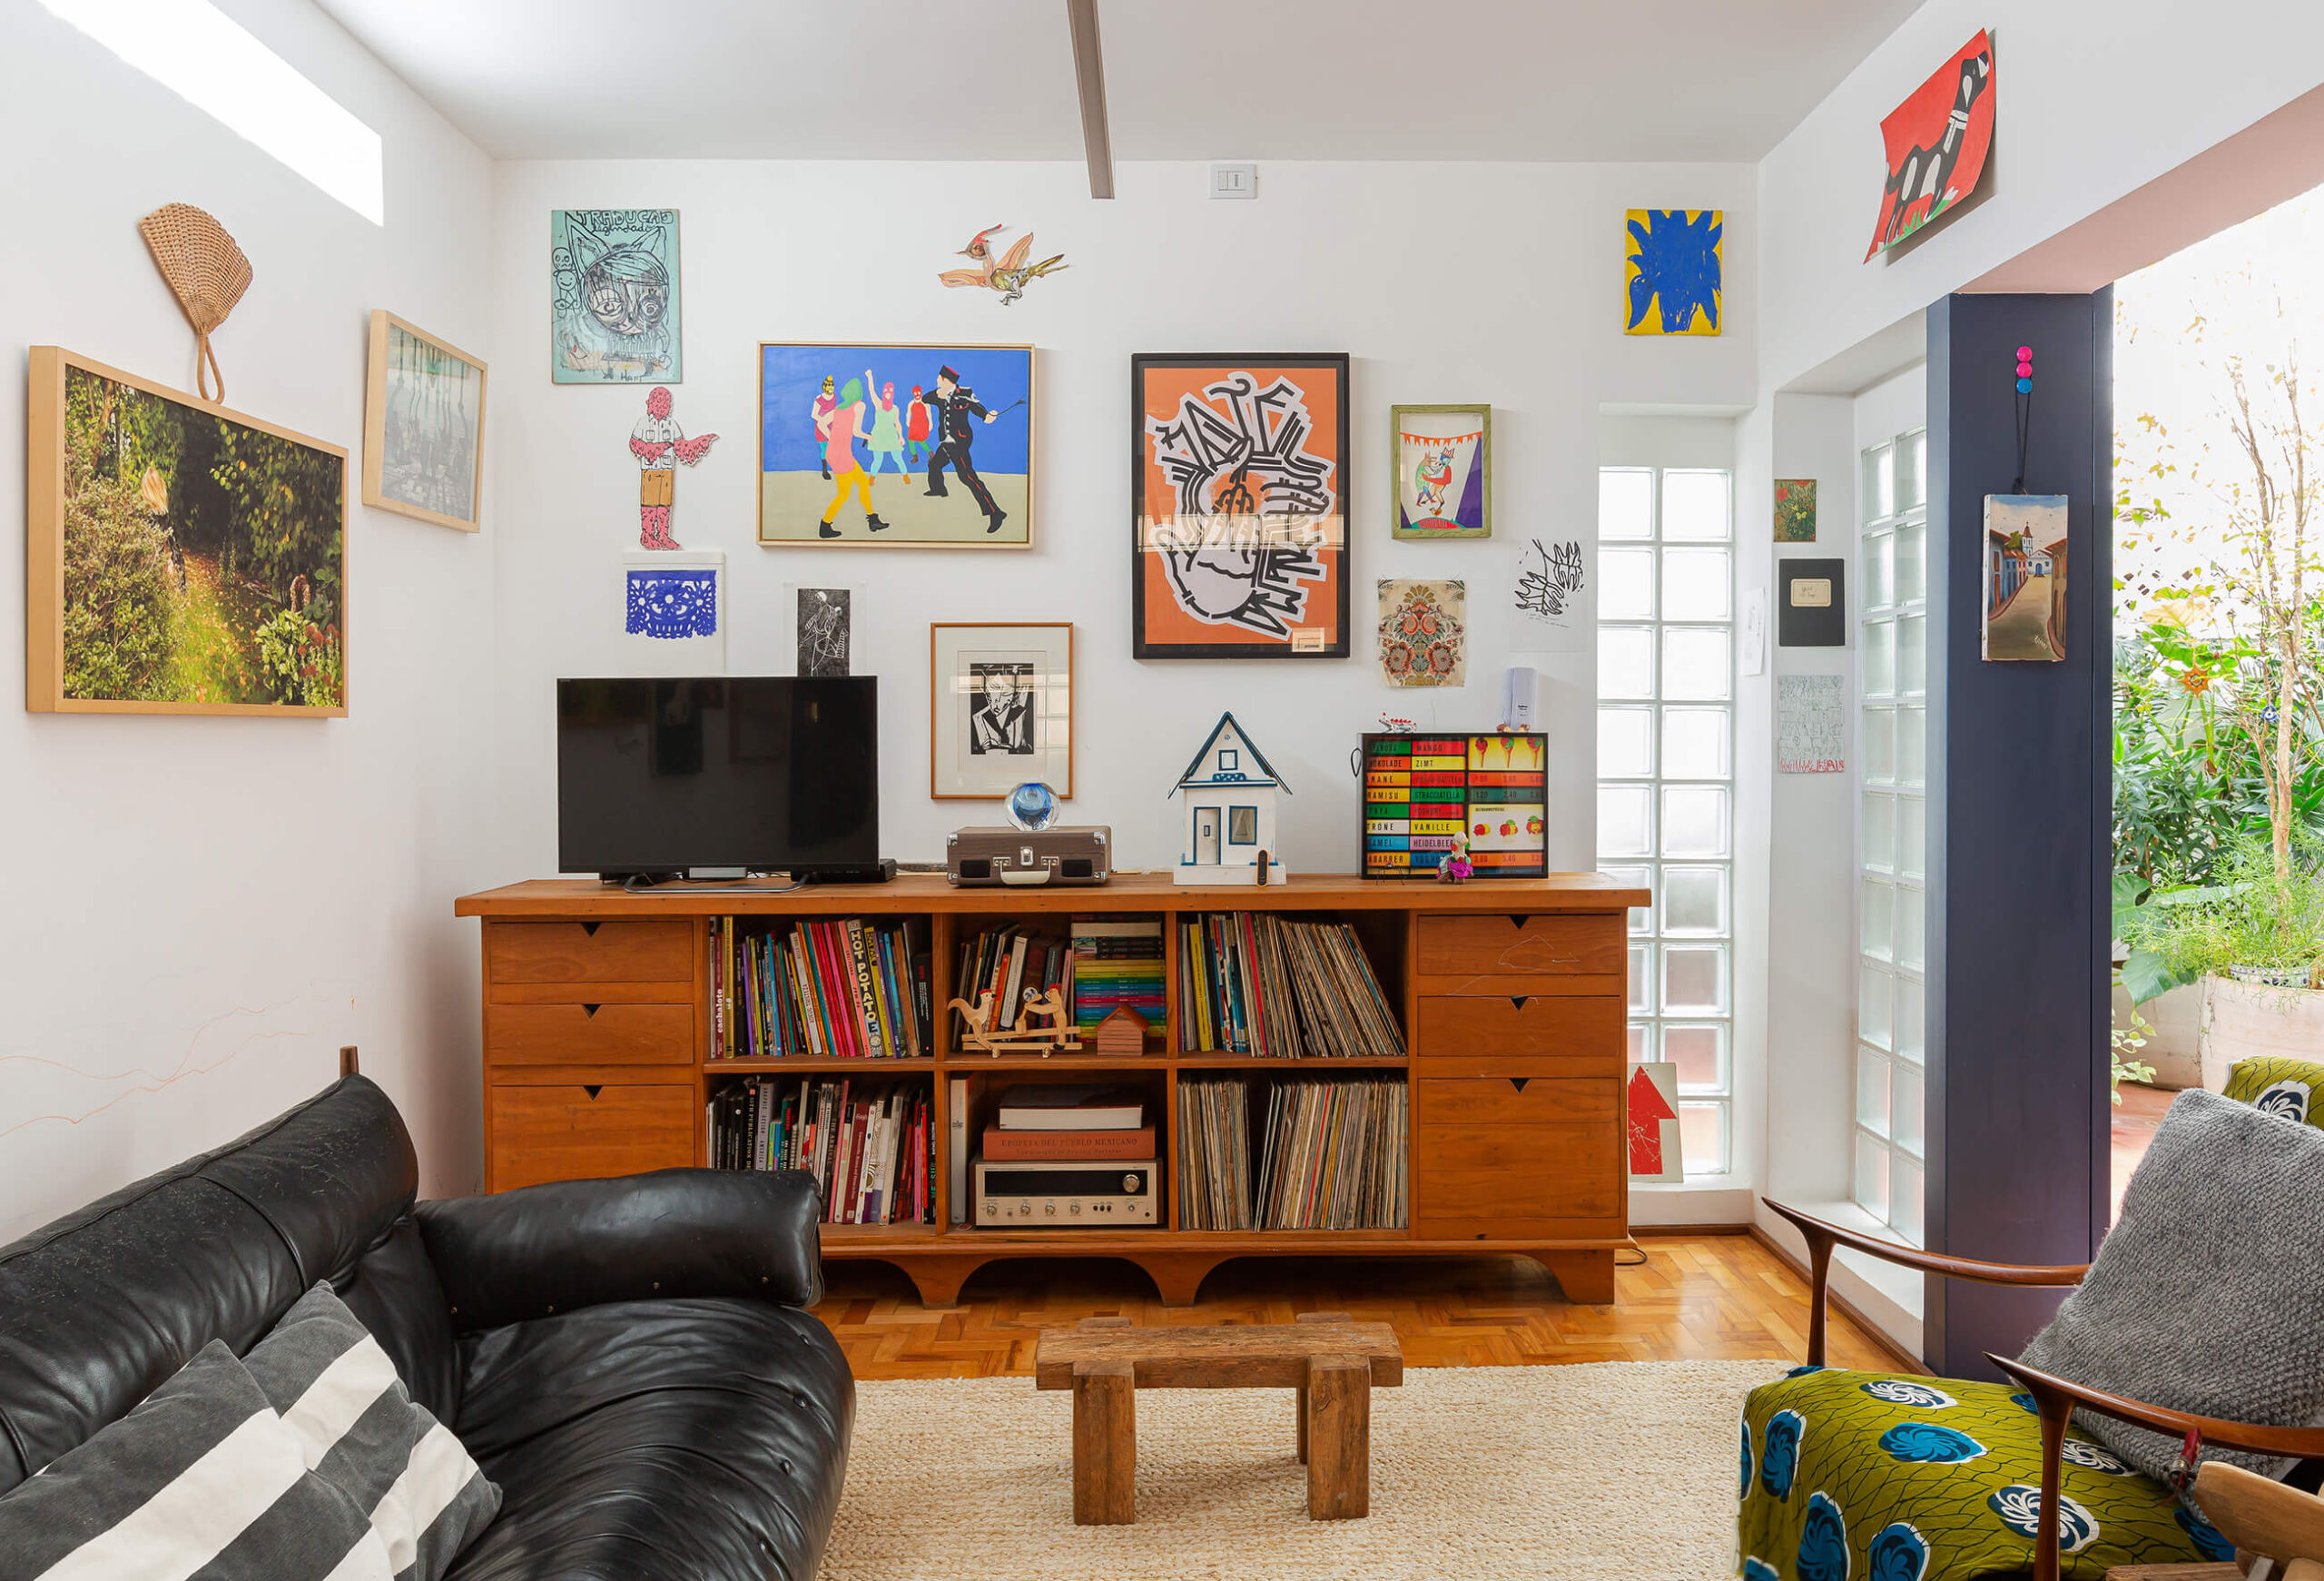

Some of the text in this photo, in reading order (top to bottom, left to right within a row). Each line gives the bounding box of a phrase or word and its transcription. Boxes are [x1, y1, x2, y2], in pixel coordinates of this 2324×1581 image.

[1413, 823, 1451, 831] VANILLE
[851, 930, 864, 960] HOT
[857, 963, 879, 1033] POTATOE
[1094, 1138, 1137, 1146] MEXICANO
